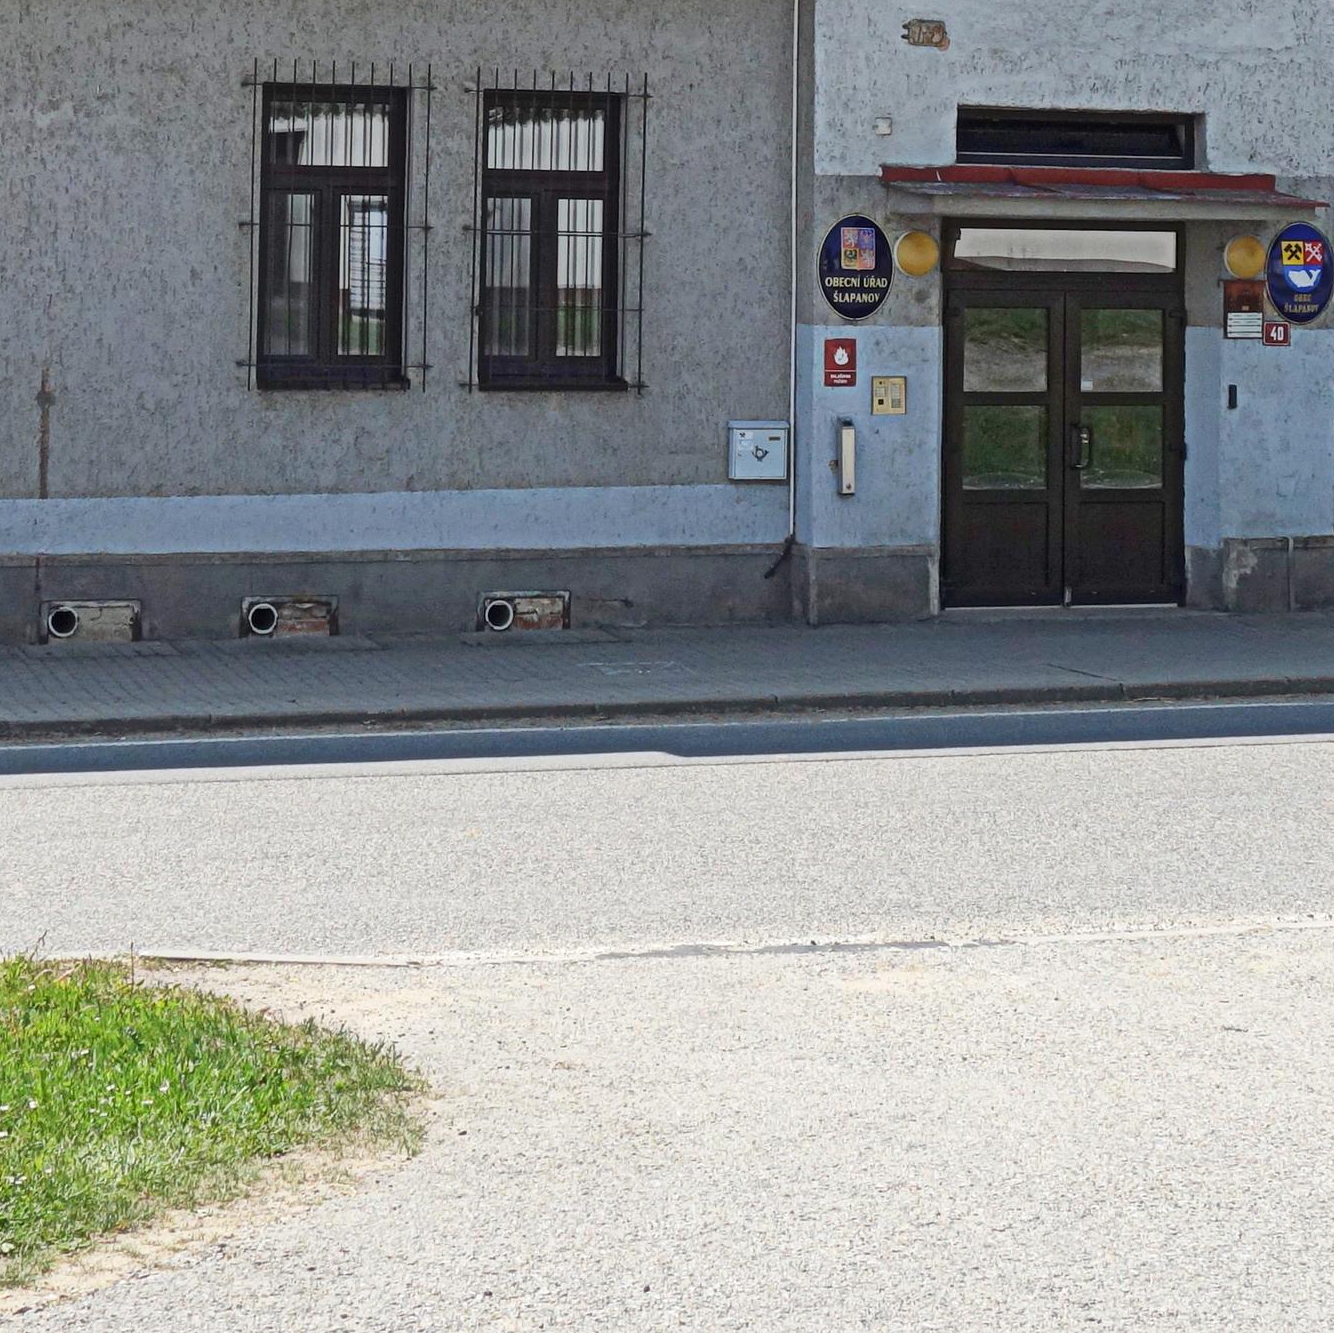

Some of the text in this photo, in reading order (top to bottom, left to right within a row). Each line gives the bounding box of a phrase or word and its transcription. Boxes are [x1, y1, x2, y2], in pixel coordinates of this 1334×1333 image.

[825, 275, 888, 288] OBECNÍ ÚŘAD
[833, 290, 880, 303] ŠLAPANOV
[1270, 326, 1284, 341] 40
